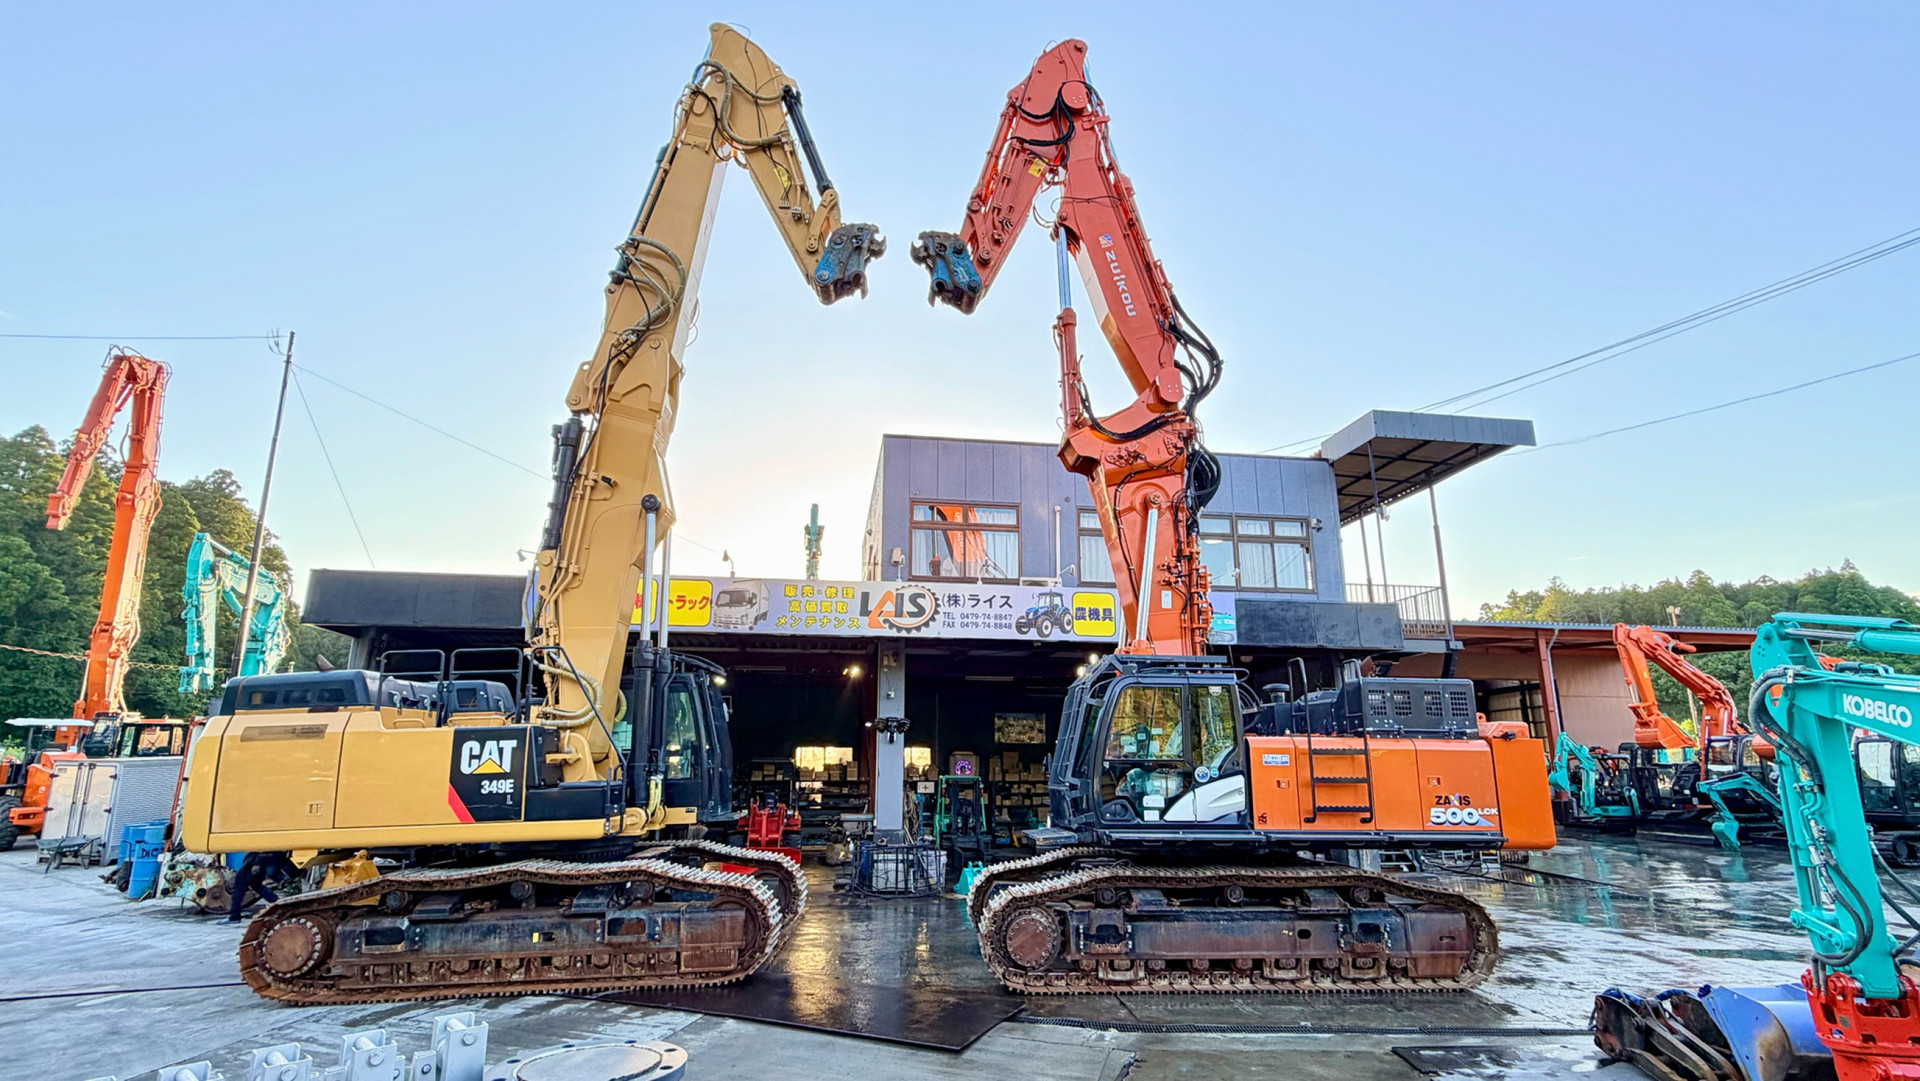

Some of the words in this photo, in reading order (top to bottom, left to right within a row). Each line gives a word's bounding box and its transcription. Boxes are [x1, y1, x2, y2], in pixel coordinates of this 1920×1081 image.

[788, 600, 849, 613] 高価買取
[859, 590, 927, 629] LAIS
[1074, 606, 1114, 622] 農機具
[775, 616, 862, 629] メンテナンス
[942, 611, 956, 620] TEL
[959, 612, 1013, 621] 0479-74-8847
[942, 620, 956, 629] FAX
[1842, 693, 1913, 728] KOBELCO
[460, 739, 517, 775] CAT
[480, 779, 514, 794] 349E
[1434, 792, 1471, 806] ZAXIS
[1430, 807, 1480, 826] 500
[1478, 807, 1499, 815] LCK
